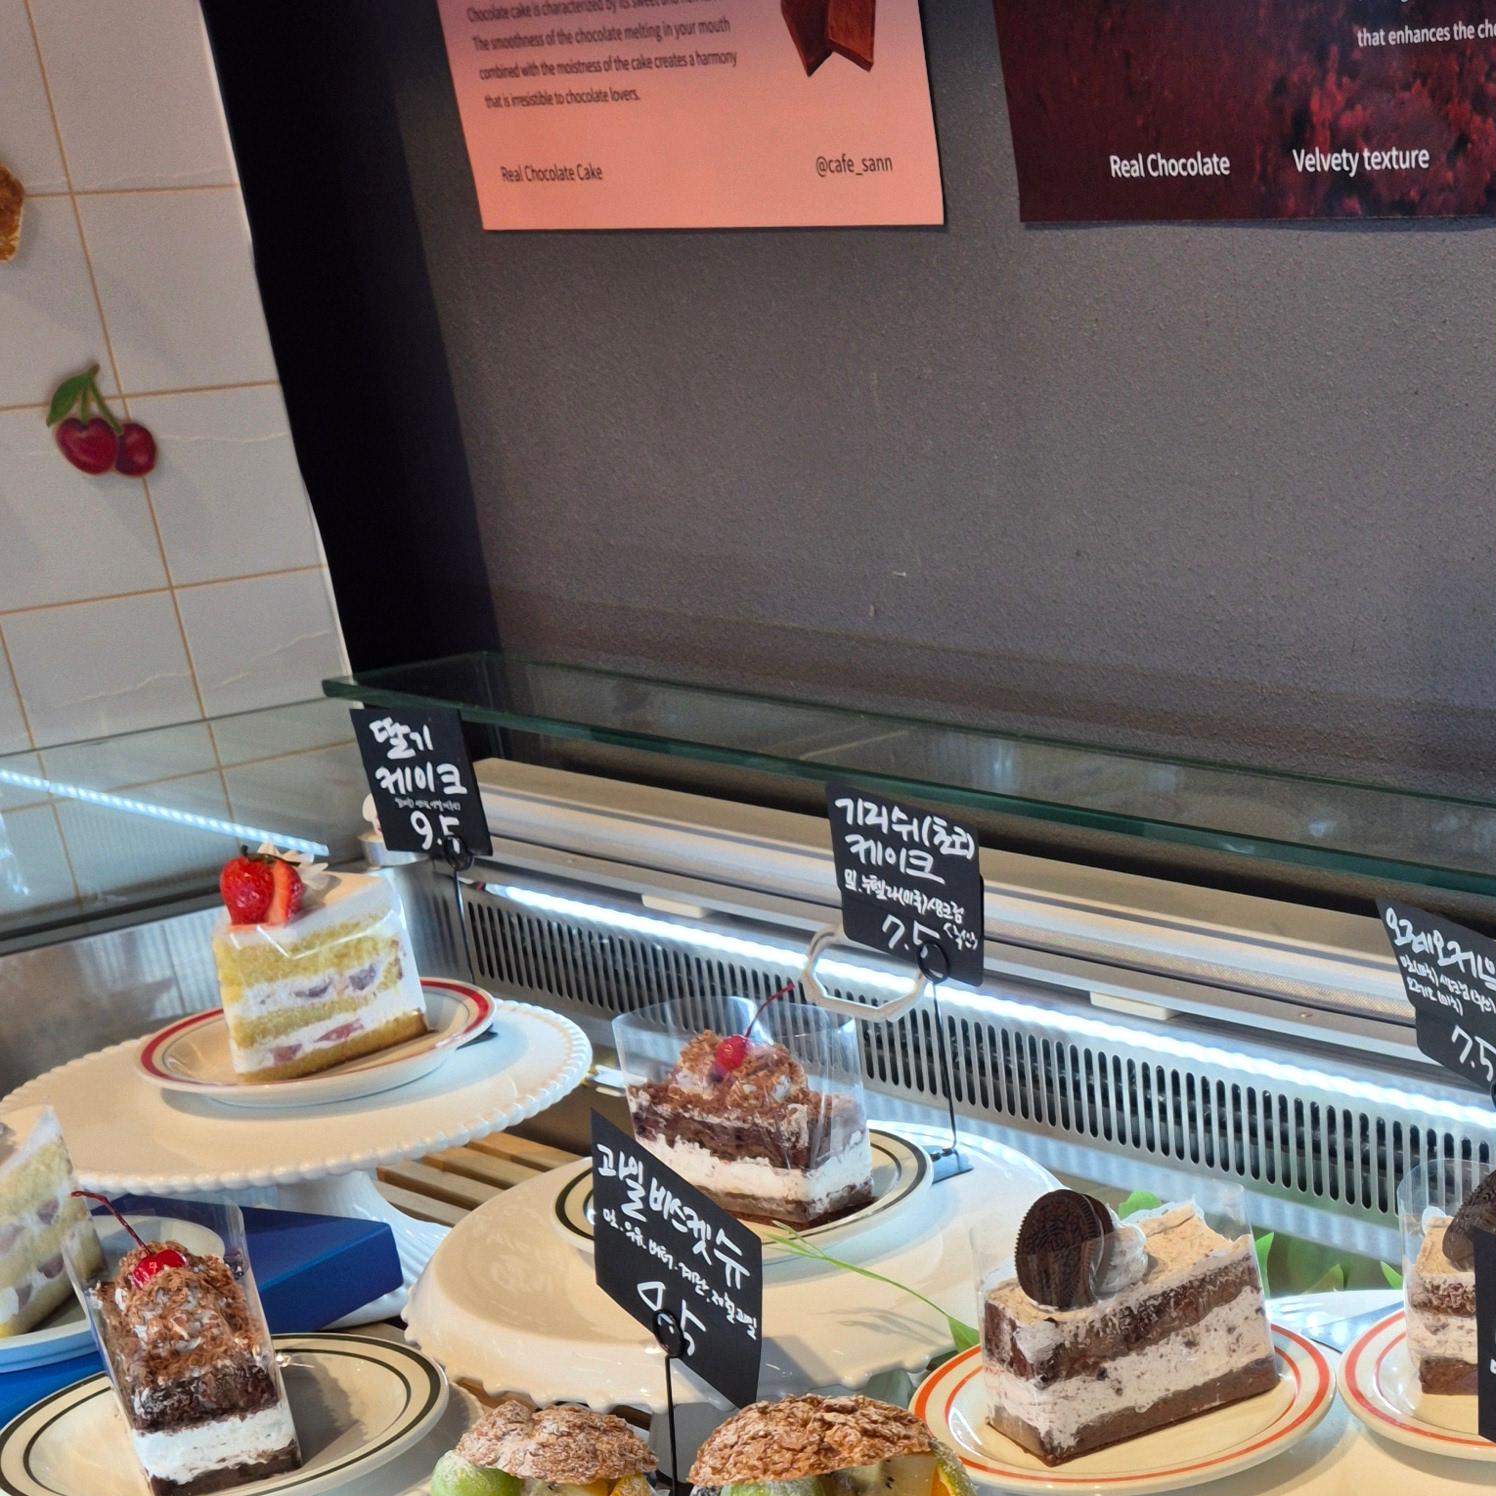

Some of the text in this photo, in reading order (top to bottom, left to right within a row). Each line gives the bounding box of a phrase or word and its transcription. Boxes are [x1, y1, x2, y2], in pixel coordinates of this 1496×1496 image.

[467, 6, 509, 22] Chocolate
[512, 3, 532, 19] cake
[472, 16, 730, 50] The smoothness of the chocolate melting in your mouth
[1357, 27, 1386, 47] that
[1388, 25, 1451, 45] enhances
[1453, 21, 1475, 41] the
[480, 62, 520, 80] combined
[521, 61, 540, 77] with
[541, 61, 555, 76] the
[556, 58, 602, 74] moistness
[603, 55, 612, 72] of
[614, 56, 629, 71] the
[631, 54, 652, 70] cake
[654, 52, 687, 69] creates
[695, 50, 737, 69] harmony
[485, 93, 503, 109] that
[555, 91, 565, 105] to
[565, 88, 609, 104] chocolate
[610, 87, 640, 102] lovers.
[500, 164, 603, 183] Real Chocolate Cake
[816, 154, 893, 177] @cafe_sann
[1109, 151, 1231, 177] Real Chocolate
[1292, 146, 1430, 177] Velvety texture
[369, 716, 434, 760] 딸기
[375, 761, 468, 795] 케이크
[410, 810, 461, 854] 9.5
[844, 834, 946, 885] 케이크
[881, 914, 941, 958] 7.5
